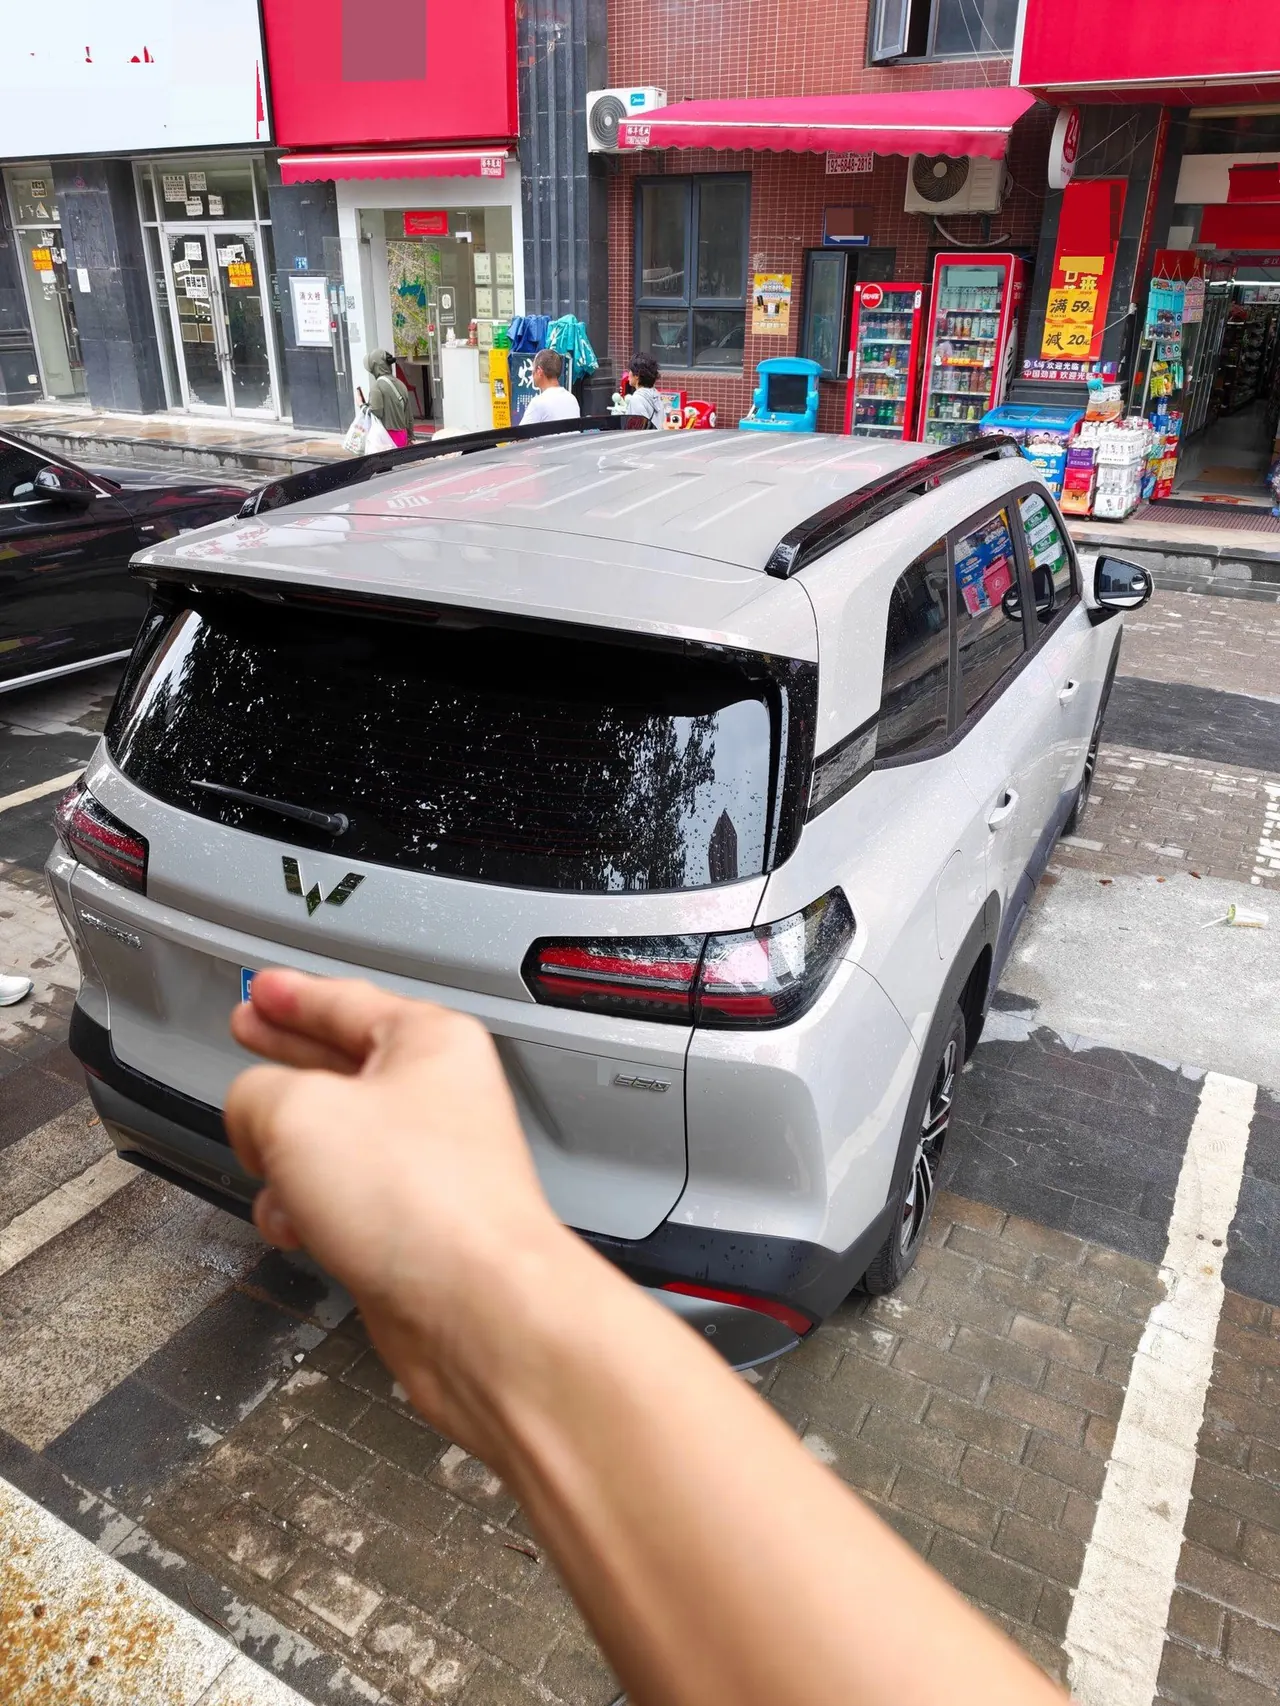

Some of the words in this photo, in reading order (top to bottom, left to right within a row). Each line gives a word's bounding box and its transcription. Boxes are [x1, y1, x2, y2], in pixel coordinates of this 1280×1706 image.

[1049, 298, 1068, 313] 满
[1045, 332, 1065, 350] 减
[1046, 361, 1079, 371] 欢迎光临
[1023, 370, 1057, 379] 中国劲酒
